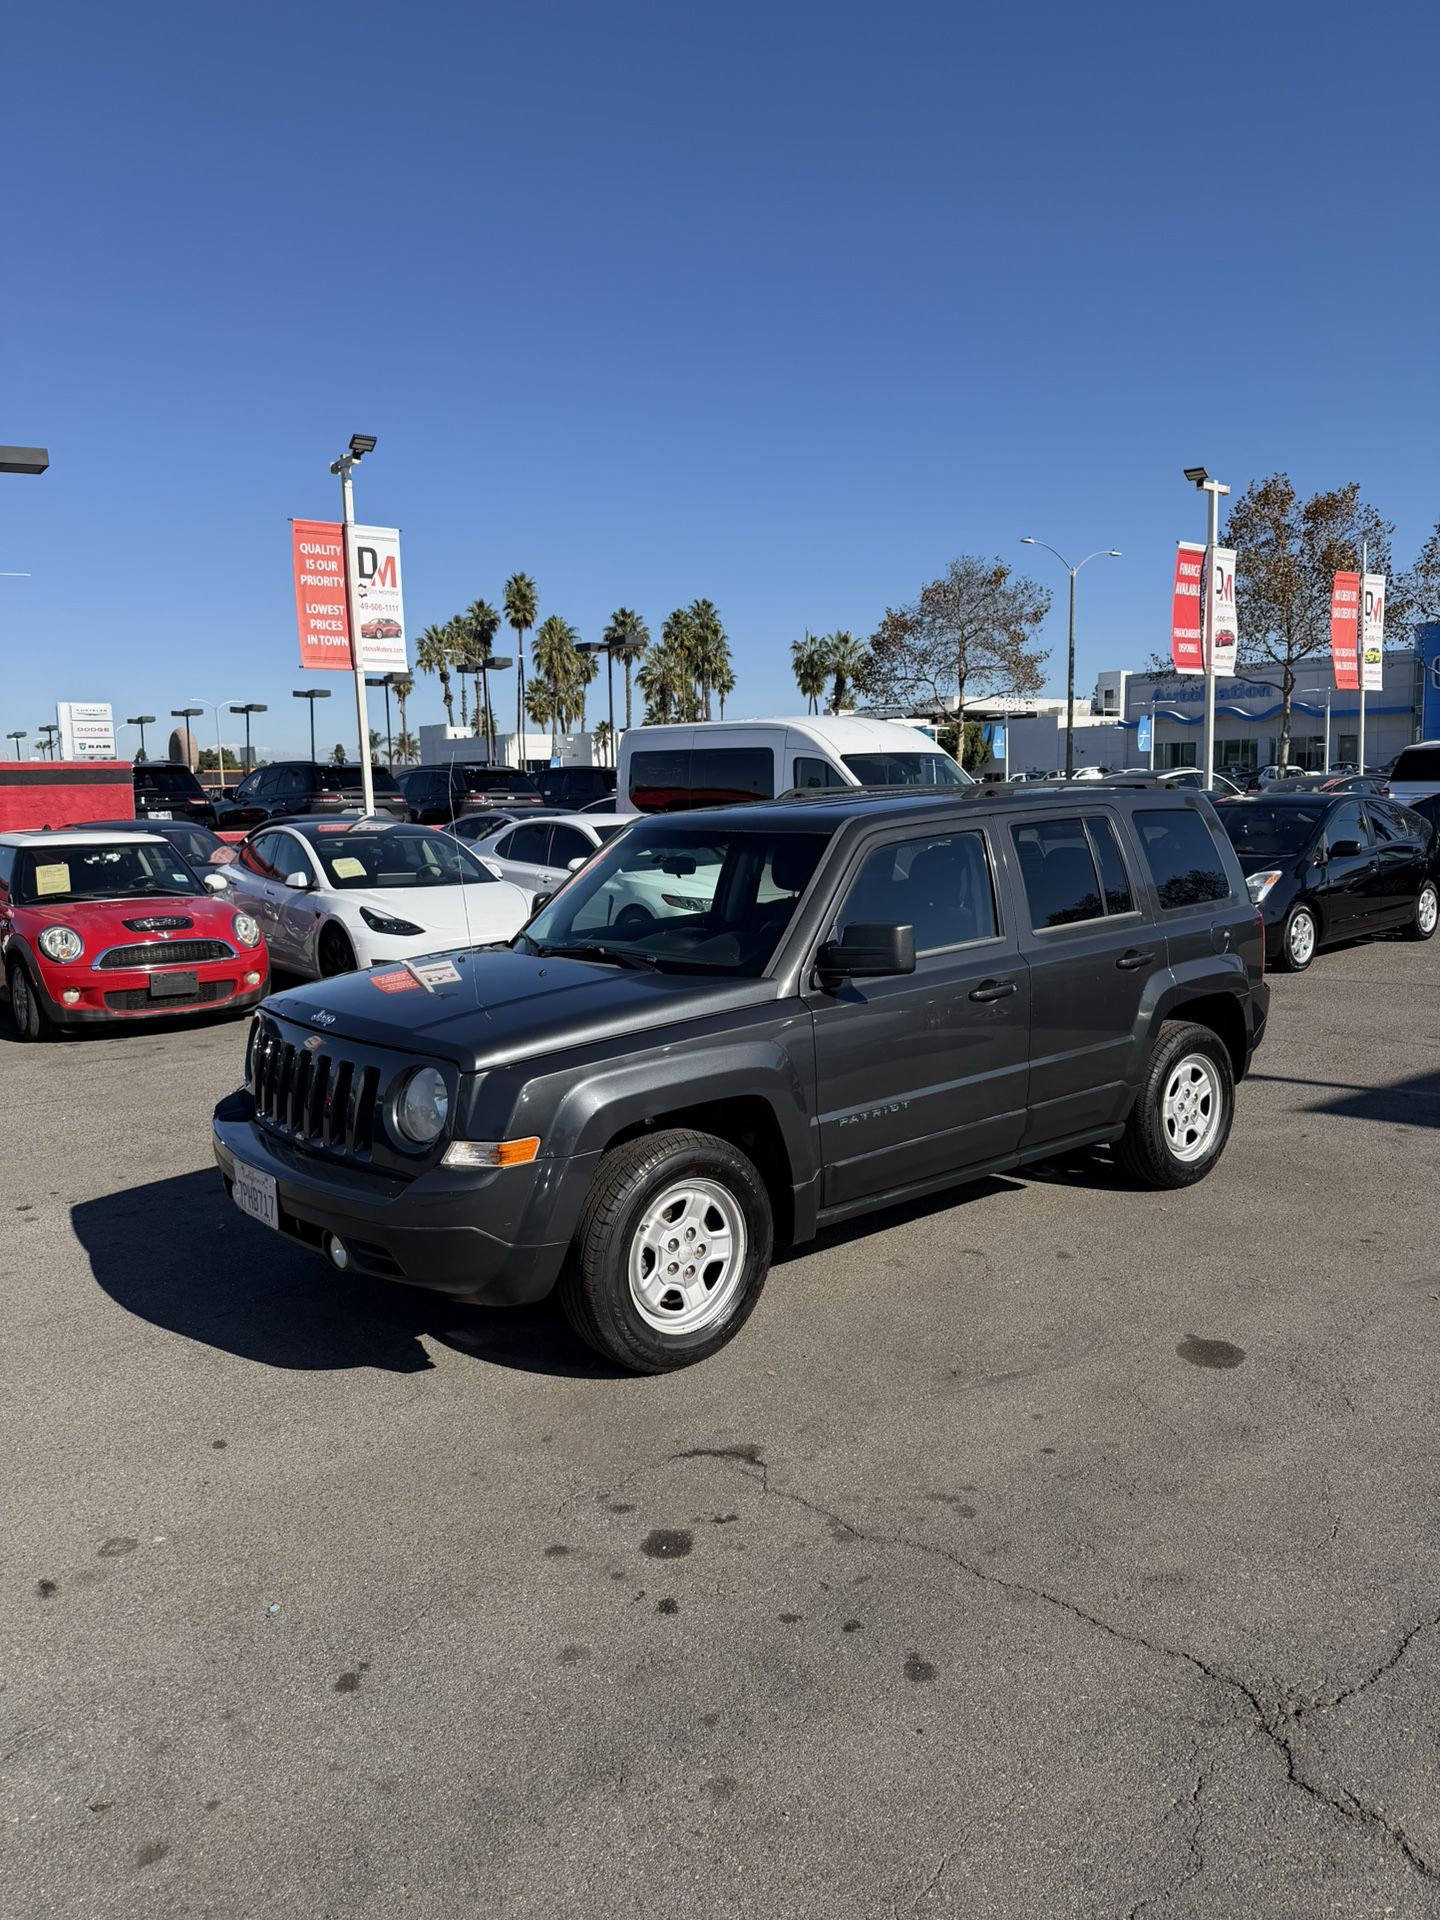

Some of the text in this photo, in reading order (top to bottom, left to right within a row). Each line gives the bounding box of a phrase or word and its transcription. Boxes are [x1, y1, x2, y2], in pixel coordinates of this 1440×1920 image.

[299, 542, 341, 556] QUALITY
[306, 559, 339, 572] IS OUR
[300, 574, 345, 588] PRIORITY
[305, 603, 345, 616] LOWEST
[310, 618, 344, 631] PRICES
[307, 634, 349, 647] IN TOWN
[839, 1100, 912, 1127] PATRIOT
